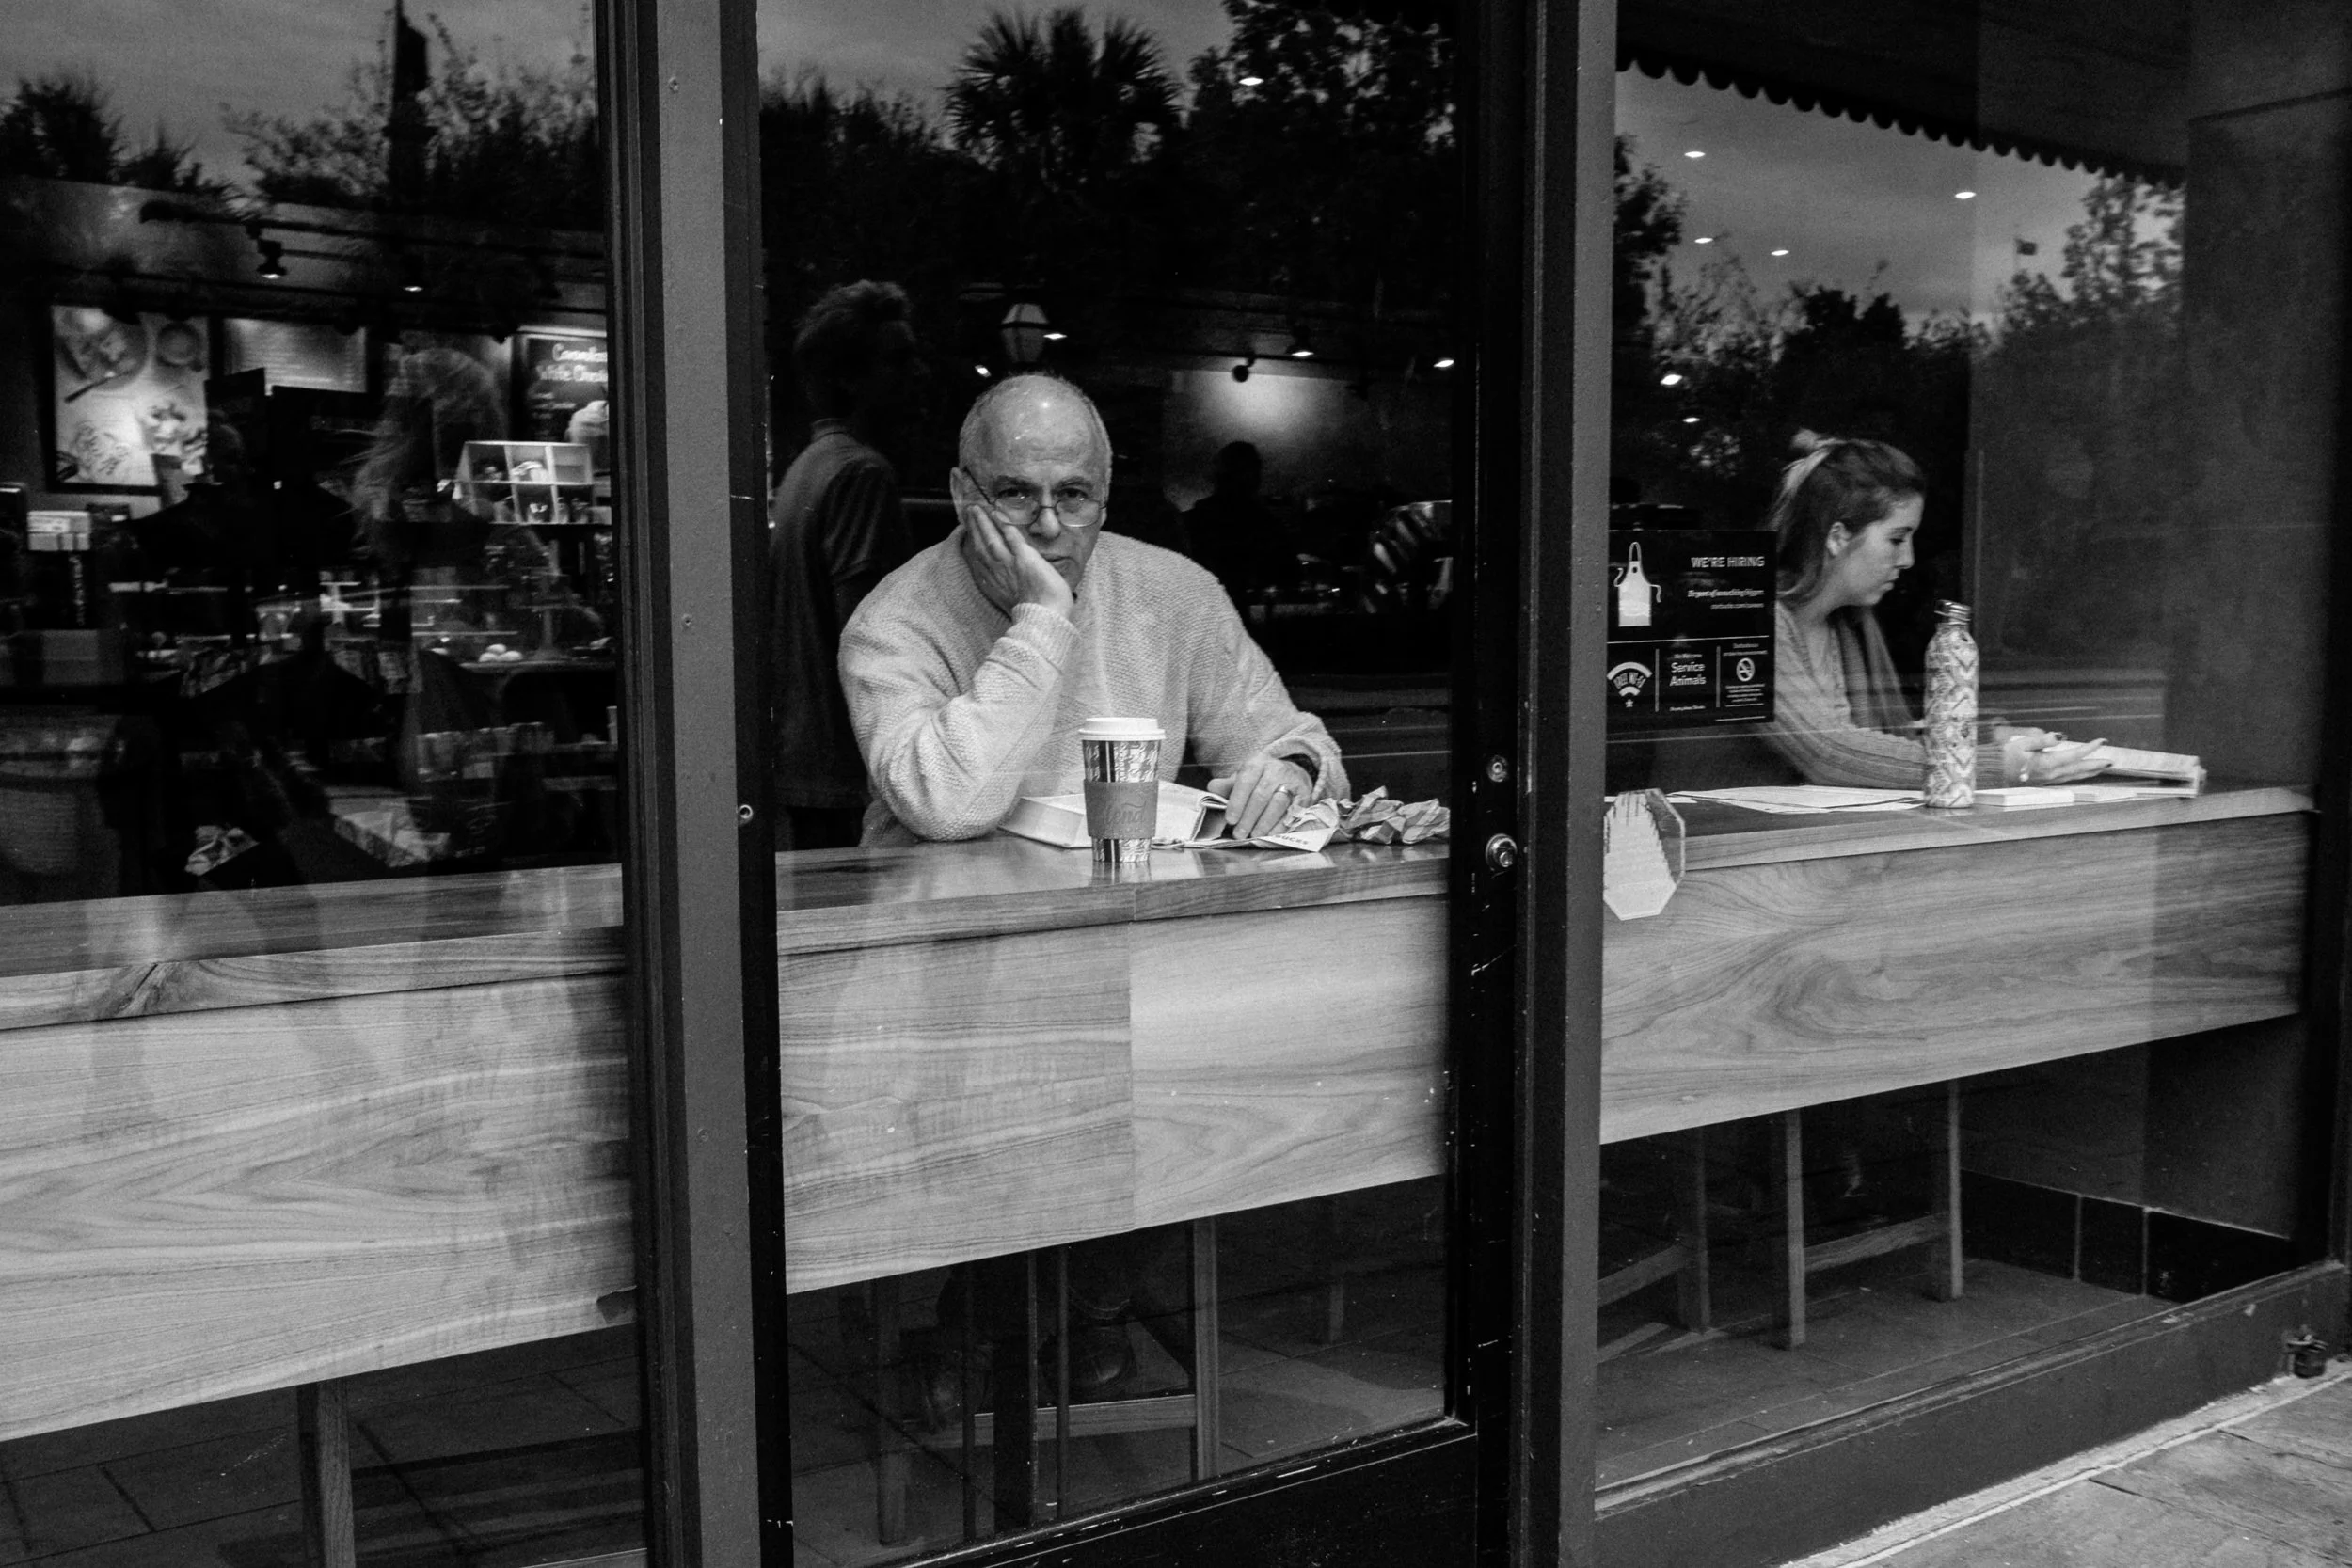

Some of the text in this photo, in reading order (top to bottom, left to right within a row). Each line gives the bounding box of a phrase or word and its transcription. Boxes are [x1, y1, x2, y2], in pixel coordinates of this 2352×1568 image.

[1691, 556, 1765, 568] WE'RE HIRING
[1670, 661, 1706, 673] Service
[1669, 673, 1707, 687] Animals
